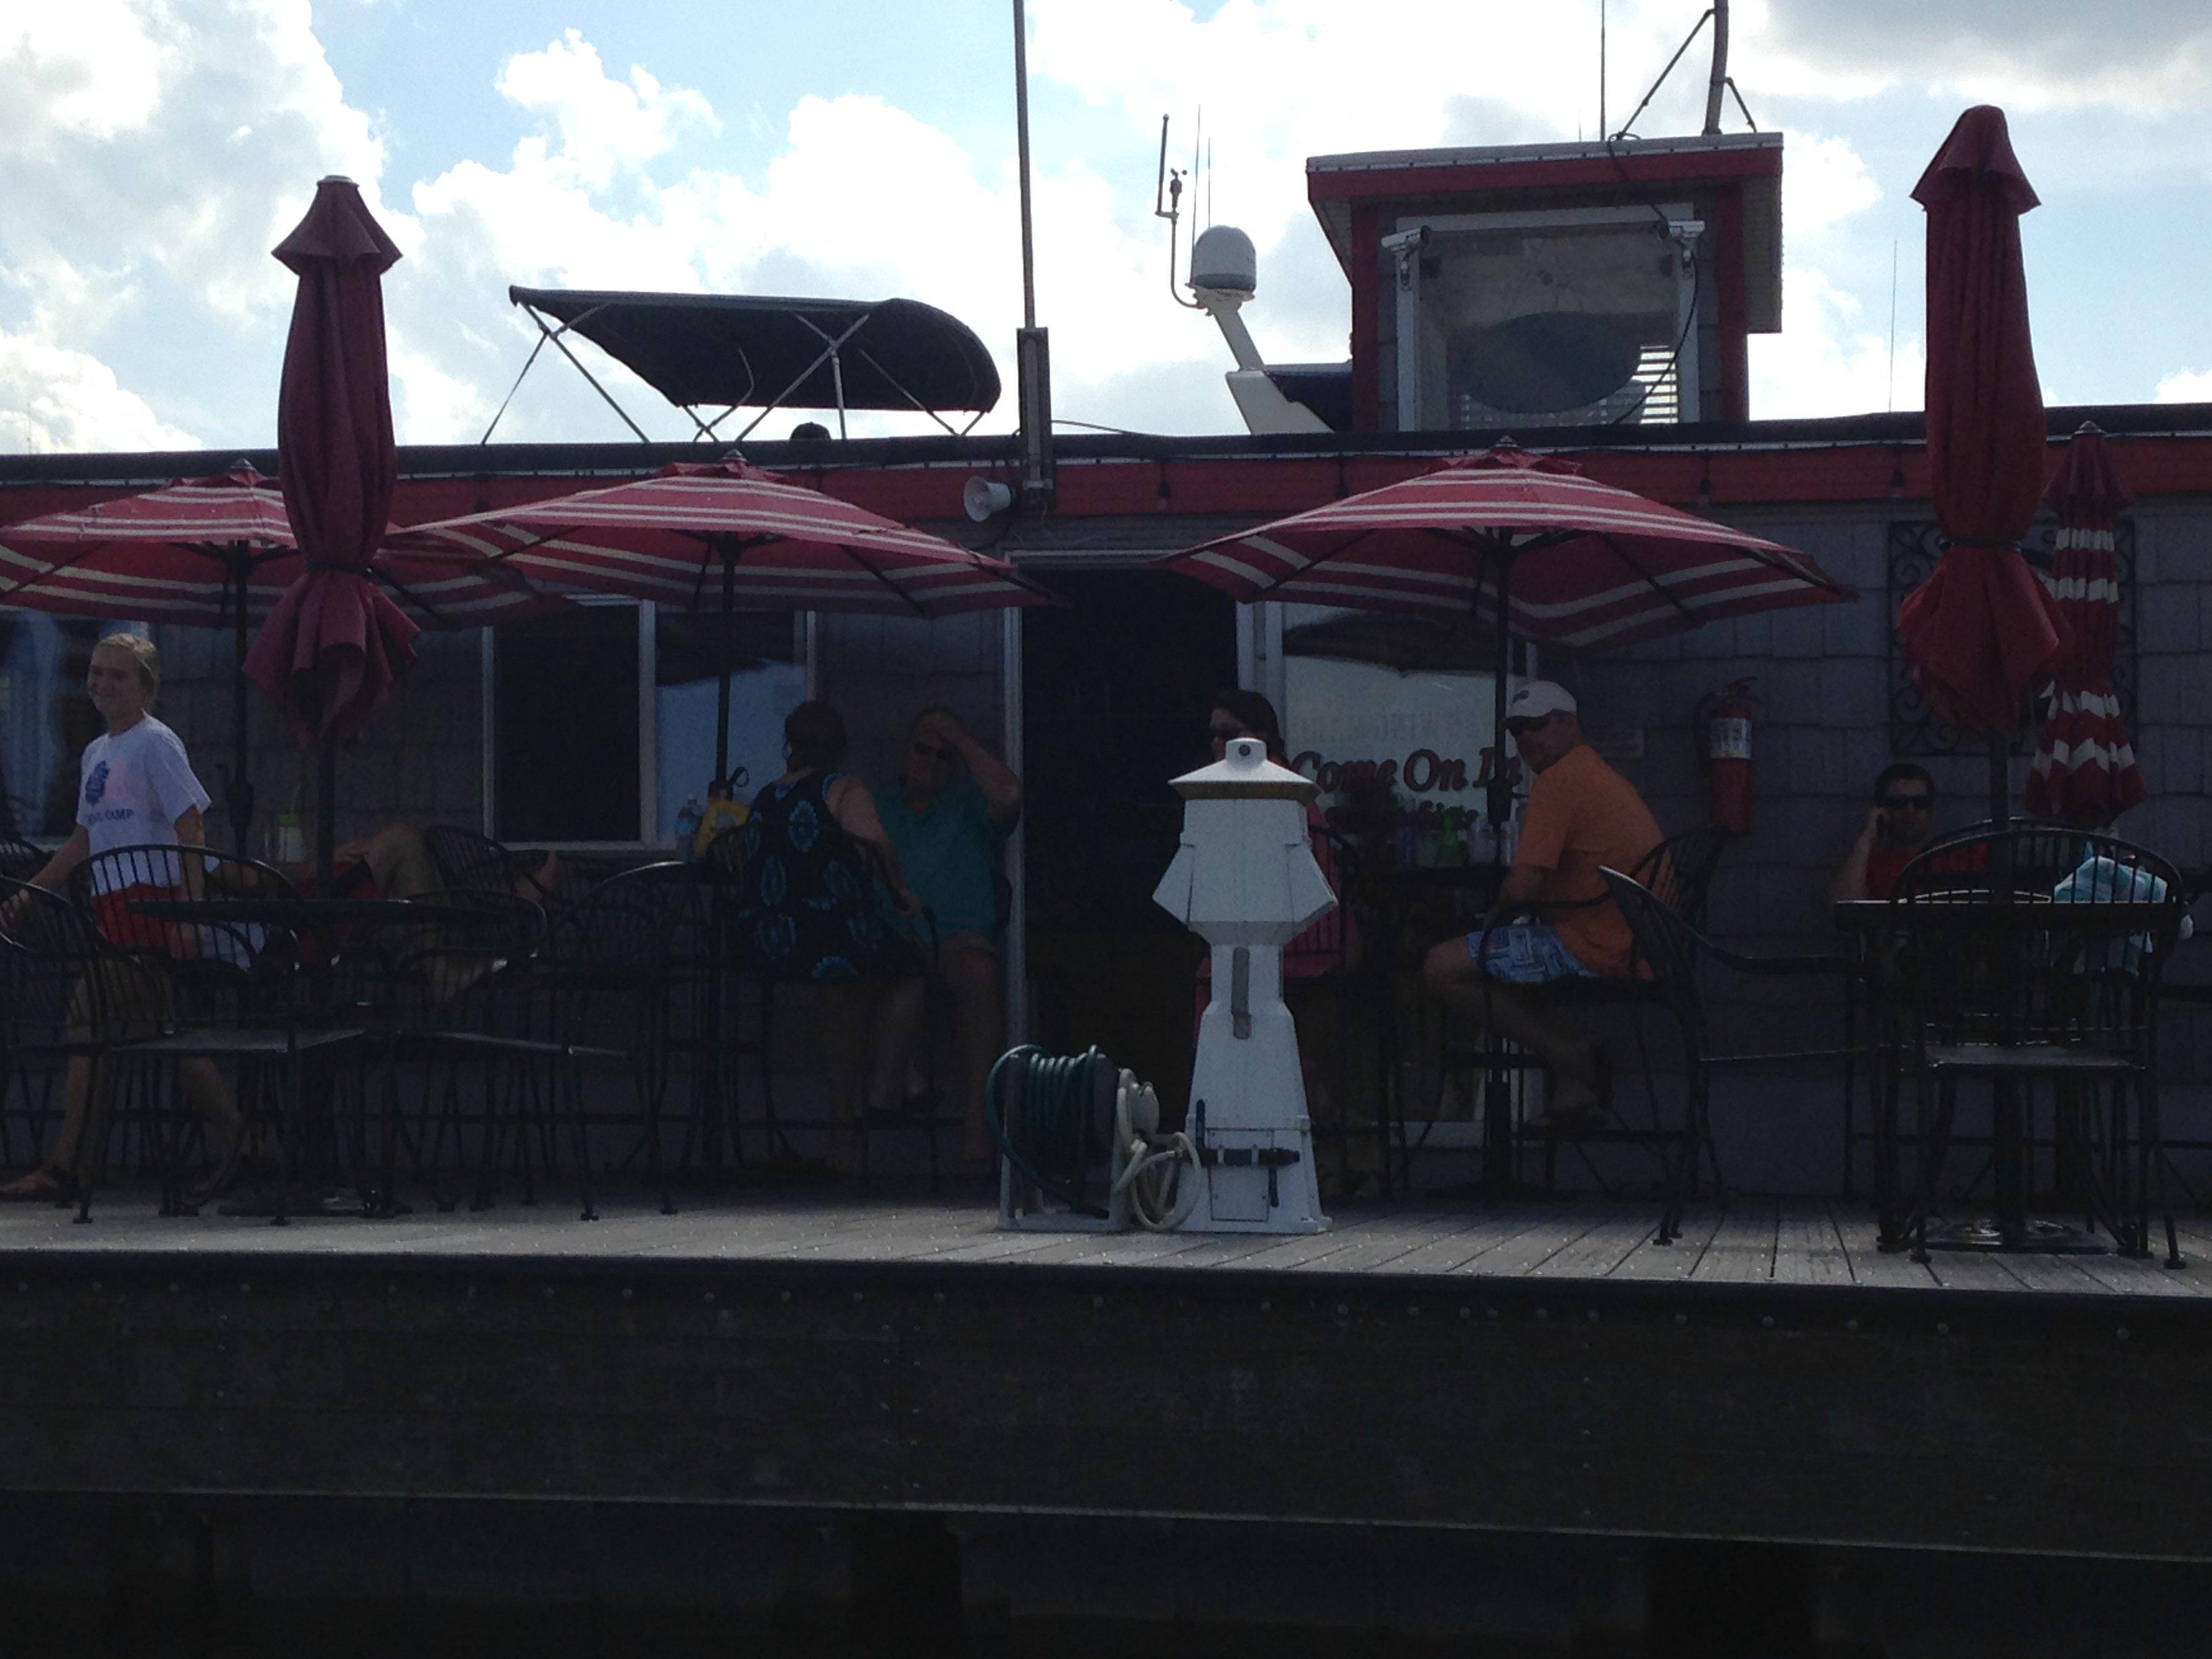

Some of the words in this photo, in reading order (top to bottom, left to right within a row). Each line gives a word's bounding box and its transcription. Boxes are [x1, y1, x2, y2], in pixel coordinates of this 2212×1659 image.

[1290, 750, 1397, 793] Come
[1404, 748, 1467, 792] On
[104, 808, 134, 821] CAMP
